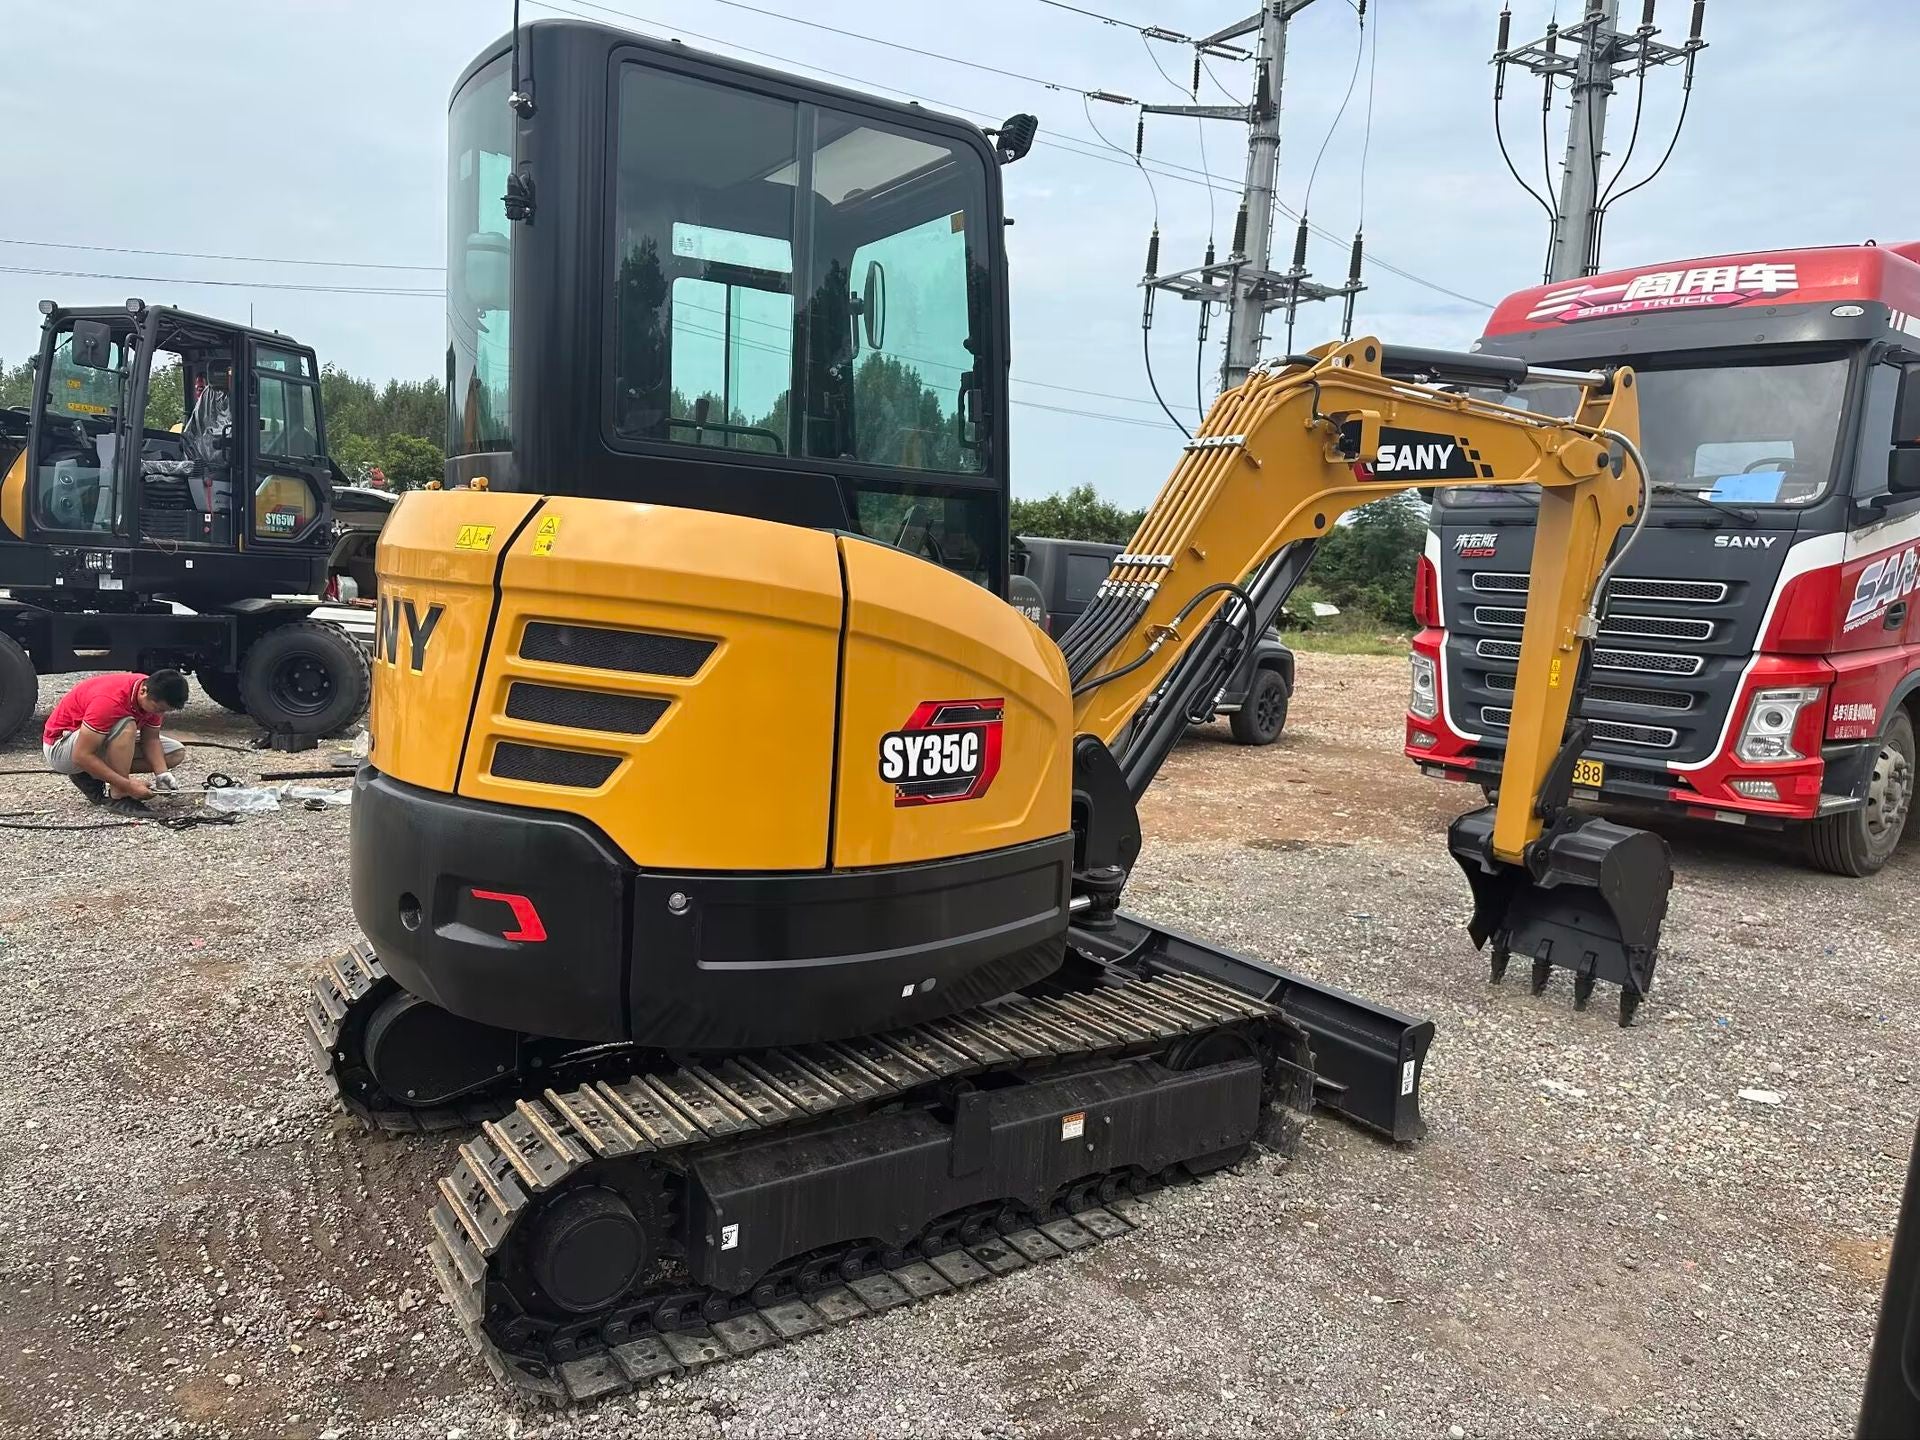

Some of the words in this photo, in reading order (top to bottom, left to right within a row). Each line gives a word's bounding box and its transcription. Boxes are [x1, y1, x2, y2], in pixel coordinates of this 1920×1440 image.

[1525, 263, 1799, 320] 三一商用车
[1576, 303, 1633, 319] SANY
[1640, 294, 1716, 310] TRUCK
[1376, 443, 1455, 472] SANY
[265, 512, 295, 527] SY65W
[1714, 535, 1777, 549] SANY
[1844, 544, 1920, 624] SAN
[882, 731, 979, 779] SY35C
